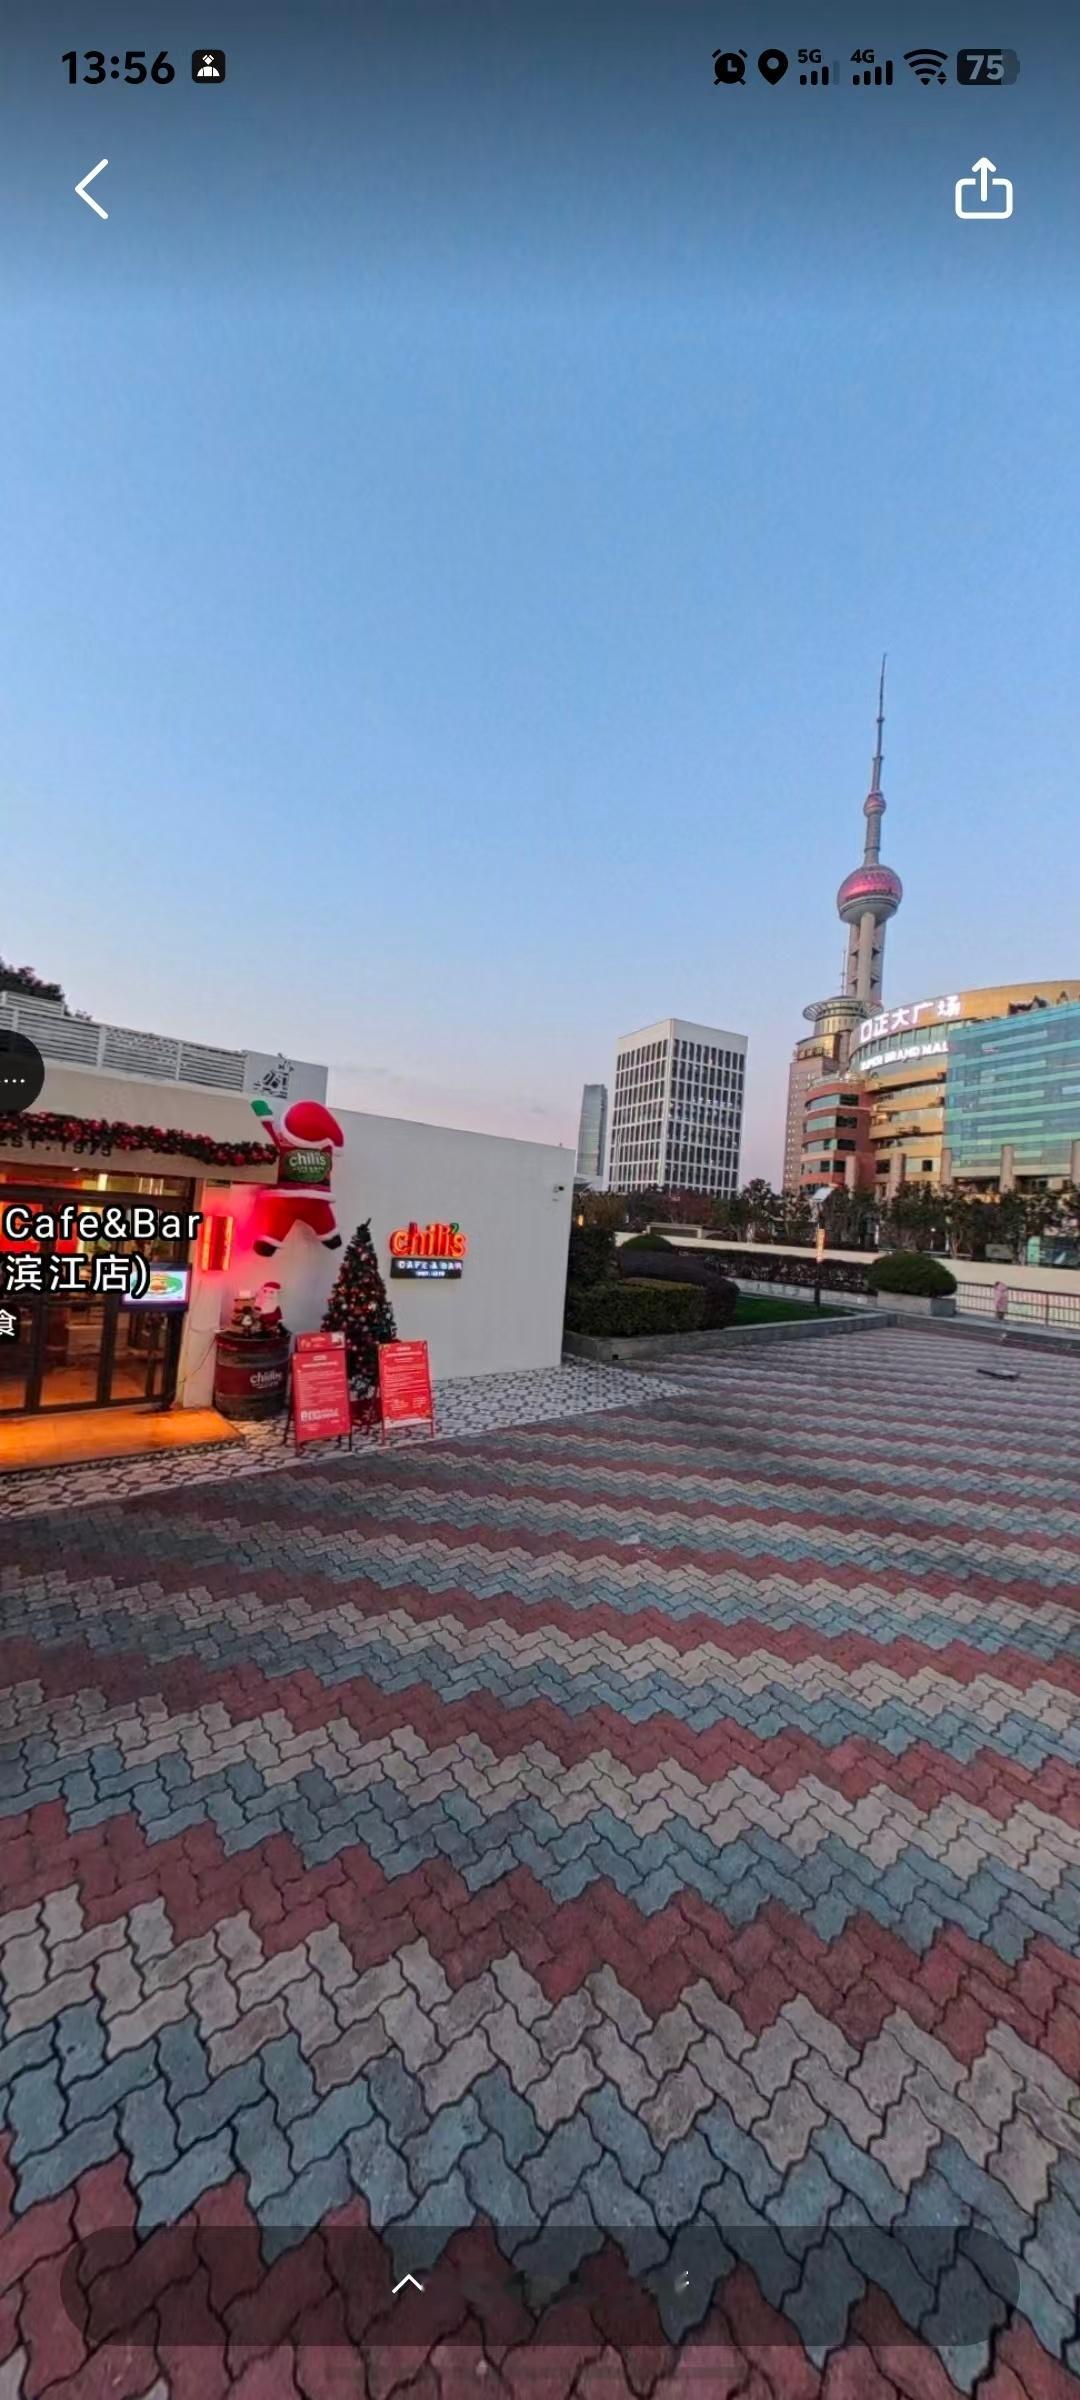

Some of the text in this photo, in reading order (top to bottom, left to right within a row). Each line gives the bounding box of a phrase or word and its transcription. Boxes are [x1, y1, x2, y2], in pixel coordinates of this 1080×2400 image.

[872, 995, 961, 1037] 正大广场
[389, 1221, 466, 1258] chili's
